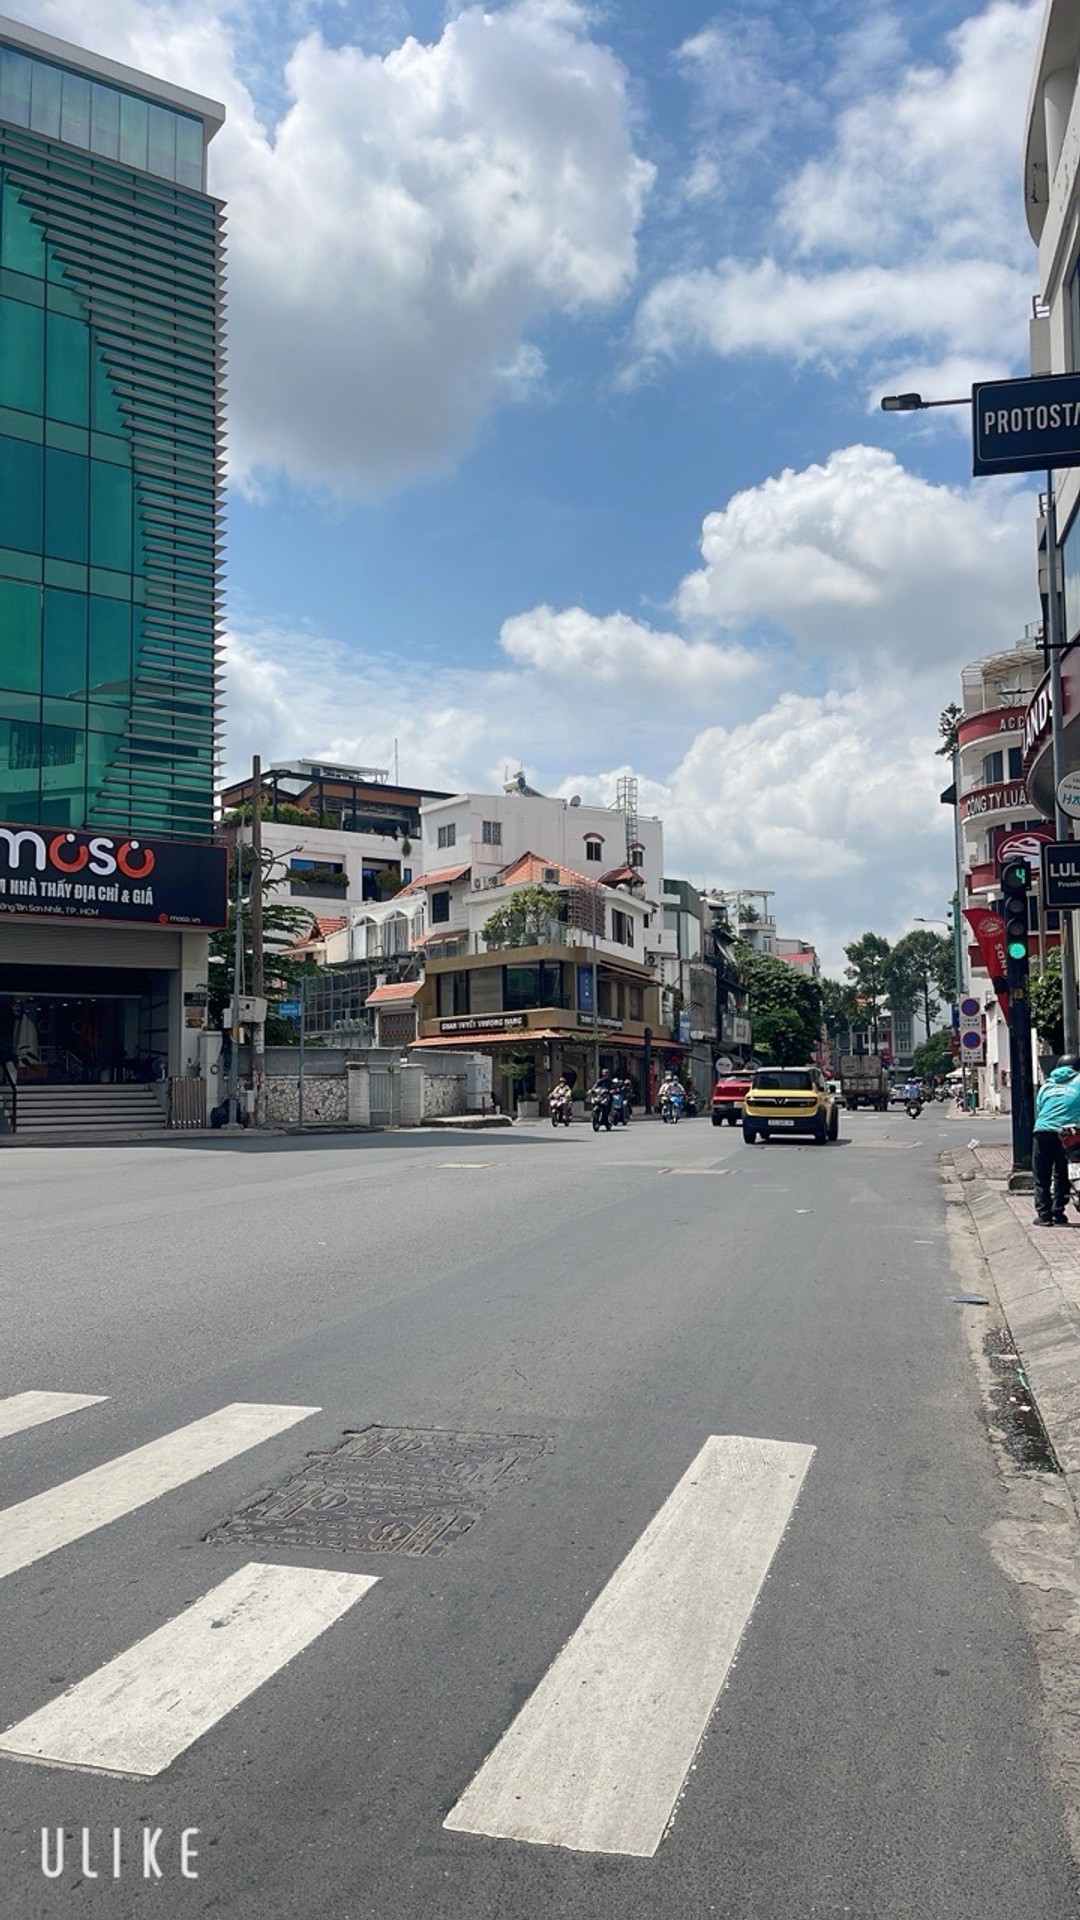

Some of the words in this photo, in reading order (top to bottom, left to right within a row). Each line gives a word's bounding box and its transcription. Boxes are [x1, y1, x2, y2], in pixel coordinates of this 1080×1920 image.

[988, 792, 1002, 810] TY
[1003, 785, 1031, 808] LUẬ
[0, 828, 155, 879] moso
[1015, 868, 1026, 885] 4
[10, 876, 38, 897] NHÀ
[40, 879, 73, 899] THẤY
[74, 884, 97, 903] ĐỊA
[121, 889, 130, 903] &
[132, 886, 154, 906] GIÁ
